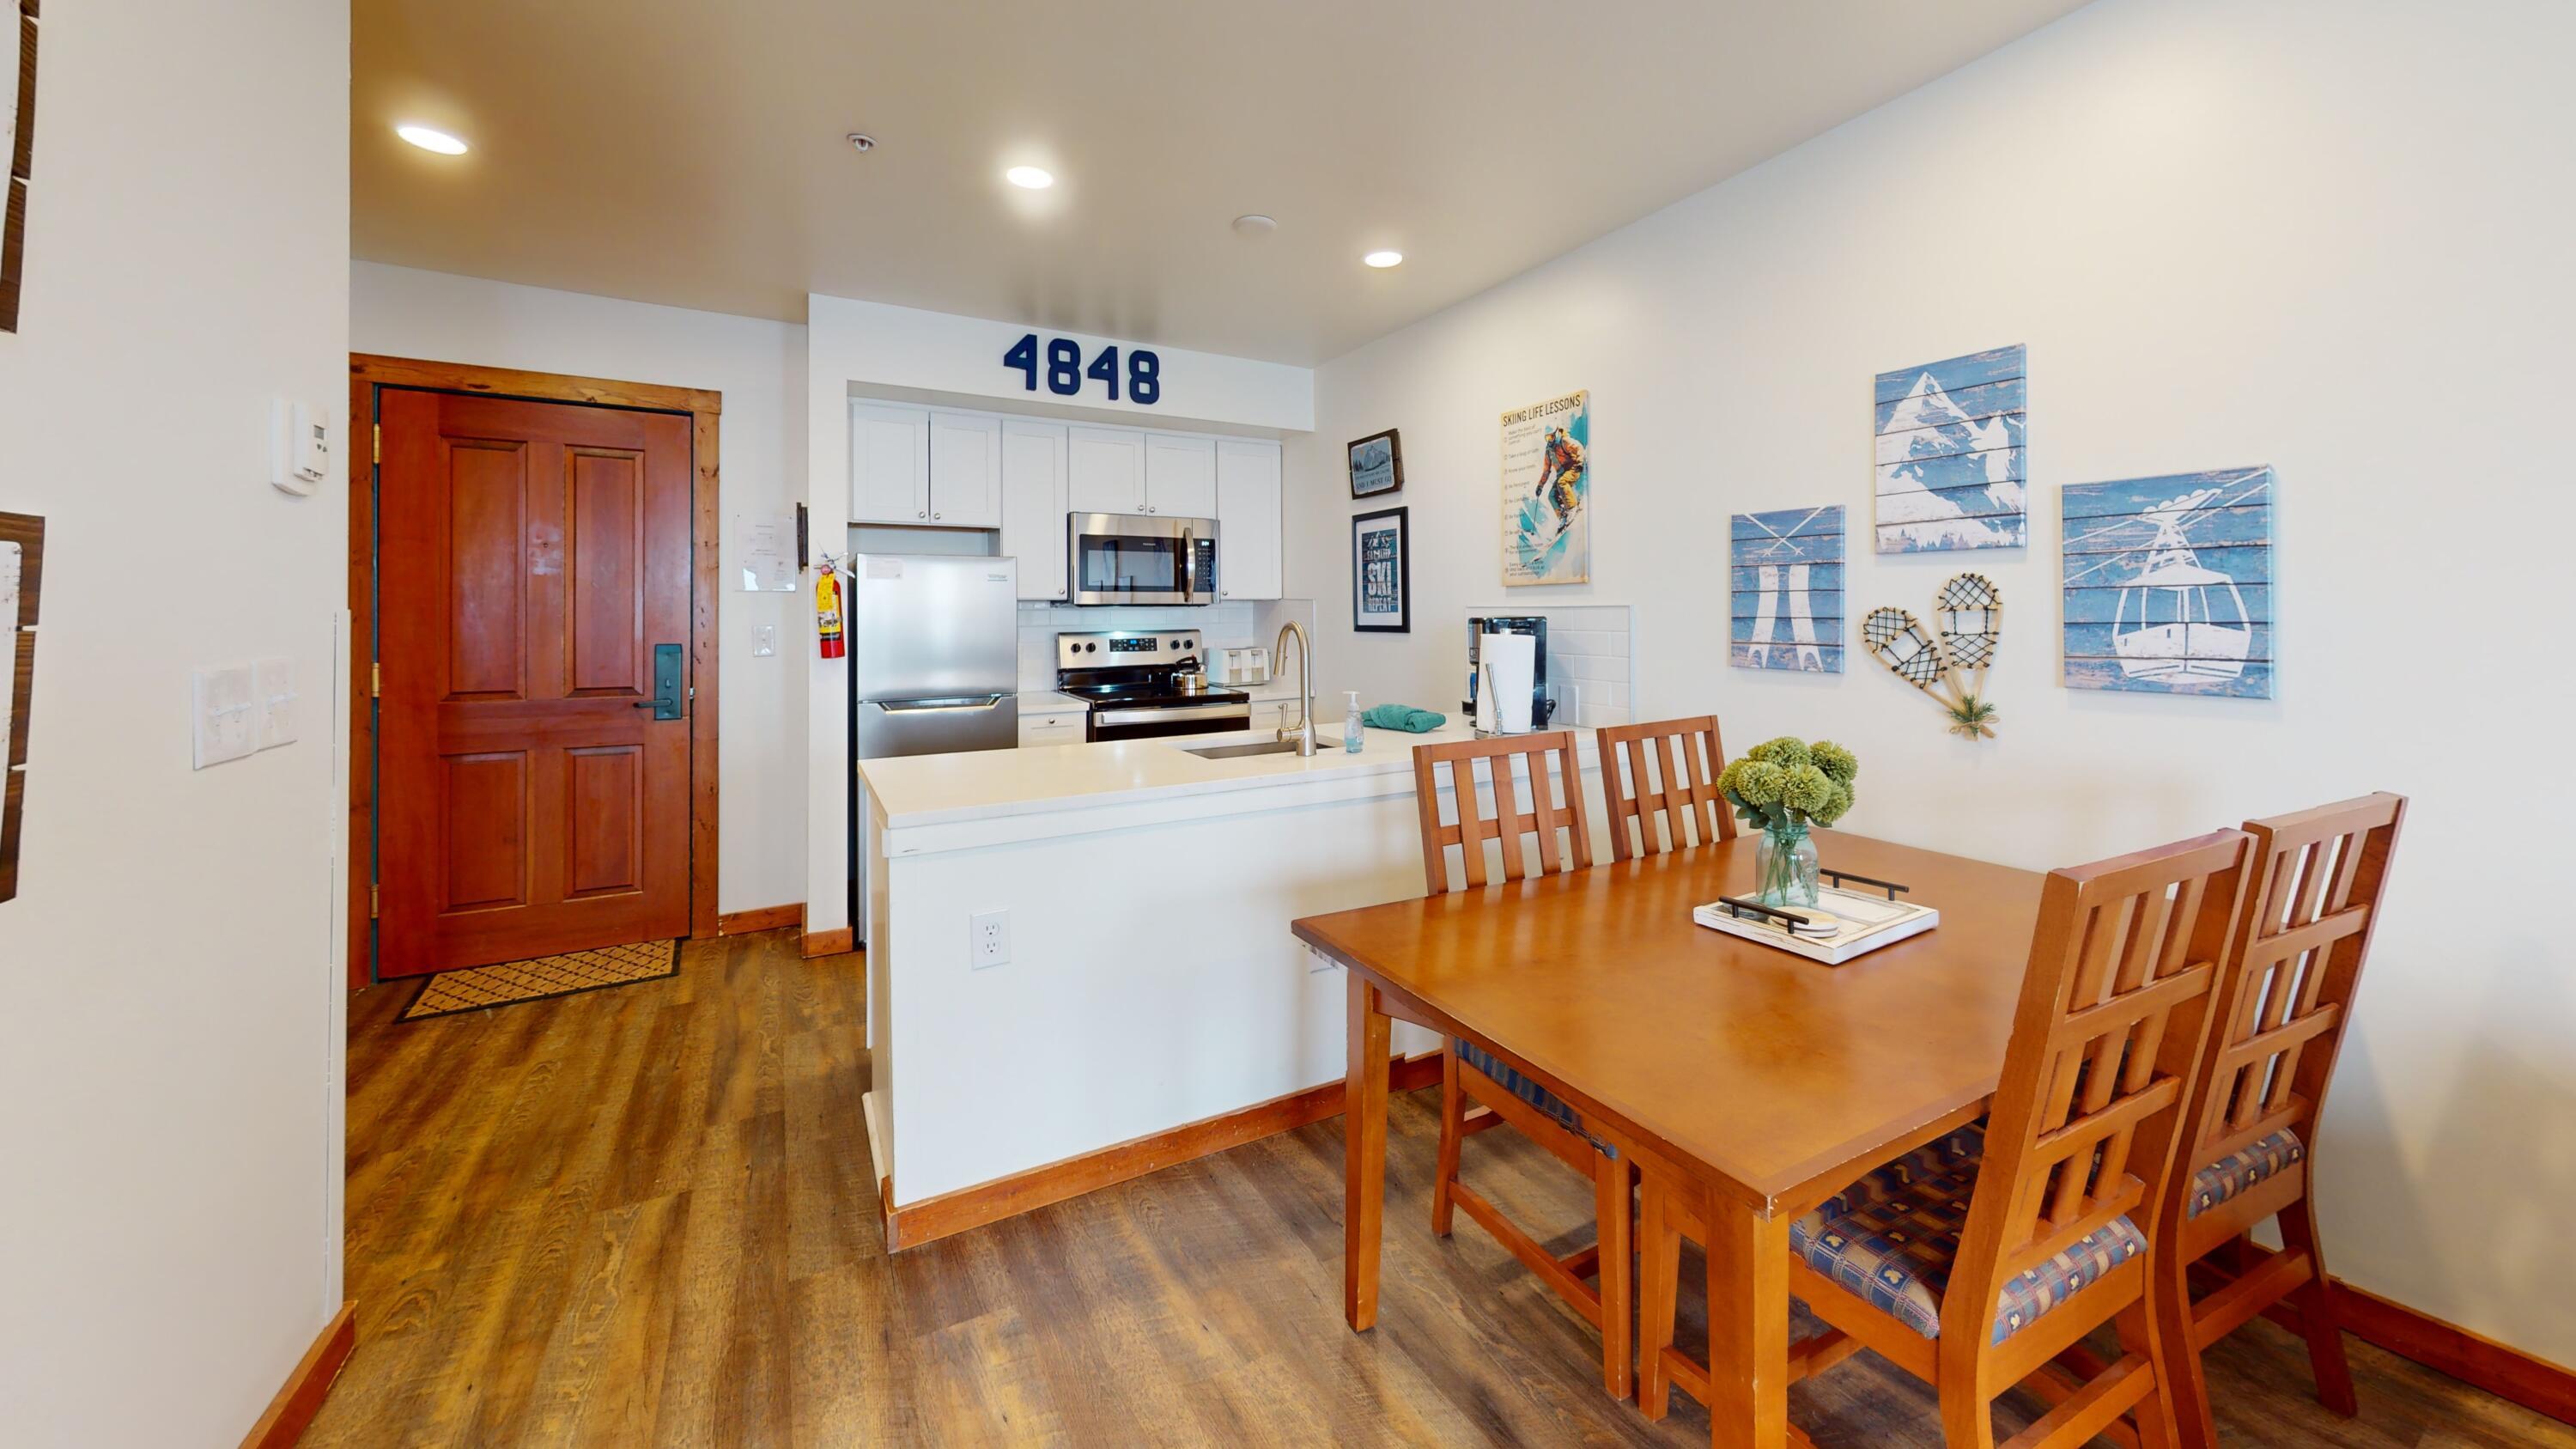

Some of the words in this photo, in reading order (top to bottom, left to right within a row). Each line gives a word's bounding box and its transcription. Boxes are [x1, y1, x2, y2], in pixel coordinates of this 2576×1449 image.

[1004, 333, 1160, 405] 4848
[1503, 411, 1527, 427] SKIING
[1528, 405, 1544, 420] LIFE
[1546, 394, 1581, 415] LESSONS
[1367, 561, 1392, 596] SKI
[1368, 597, 1392, 612] REPEAT
